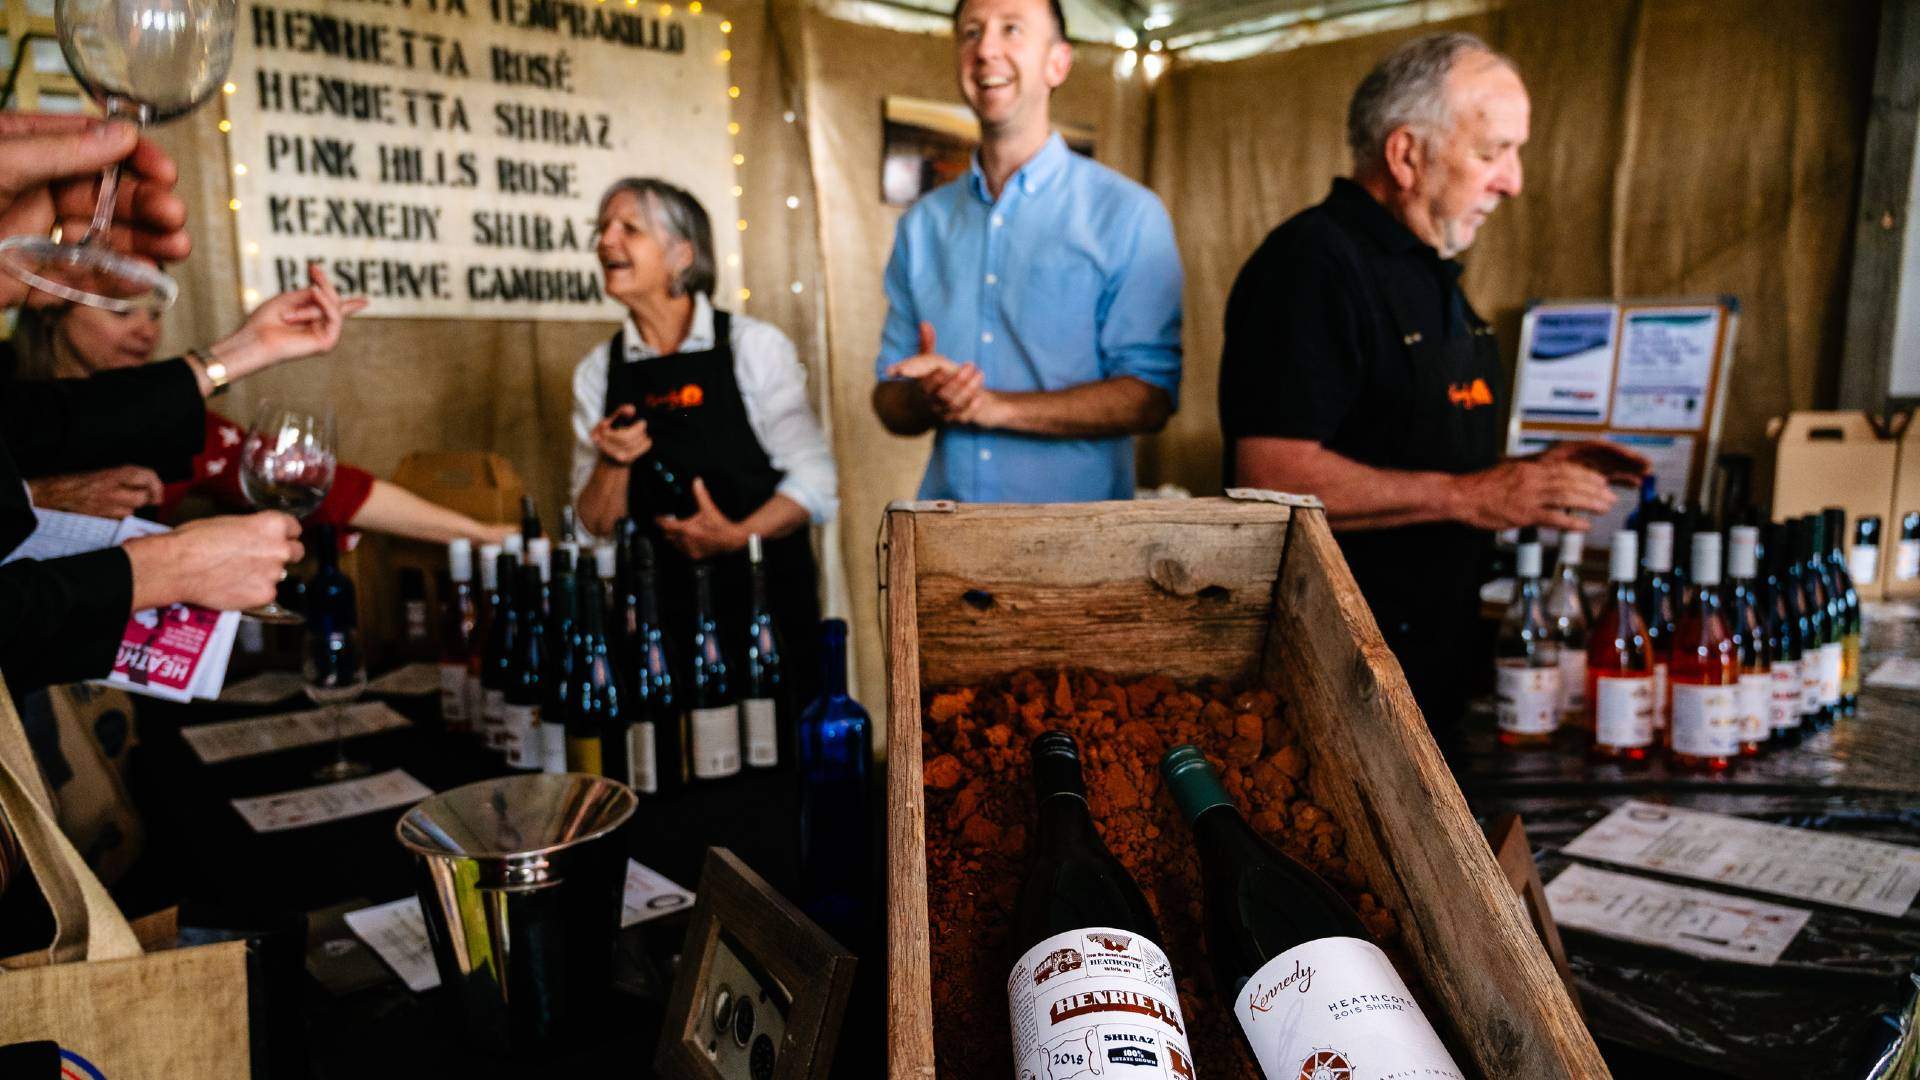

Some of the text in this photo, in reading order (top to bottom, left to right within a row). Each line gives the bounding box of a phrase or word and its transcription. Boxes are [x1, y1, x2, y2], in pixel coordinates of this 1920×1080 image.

[252, 6, 469, 78] HENRIETTA
[256, 68, 613, 149] HENRIETTA SHIRAZ
[267, 133, 581, 198] PINK HILLS ROSE
[268, 193, 441, 241] KENNEDY
[1090, 958, 1142, 970] HEATHCOTE
[1250, 960, 1316, 1020] Kennedy
[1328, 994, 1415, 1012] HEATHCOTE
[1050, 990, 1184, 1035] HENRIETT
[1334, 1003, 1404, 1020] 2015 SHIRAZ
[1103, 1033, 1155, 1045] SHIRAZ
[1123, 1049, 1144, 1059] 100%
[1053, 1053, 1084, 1066] 2018
